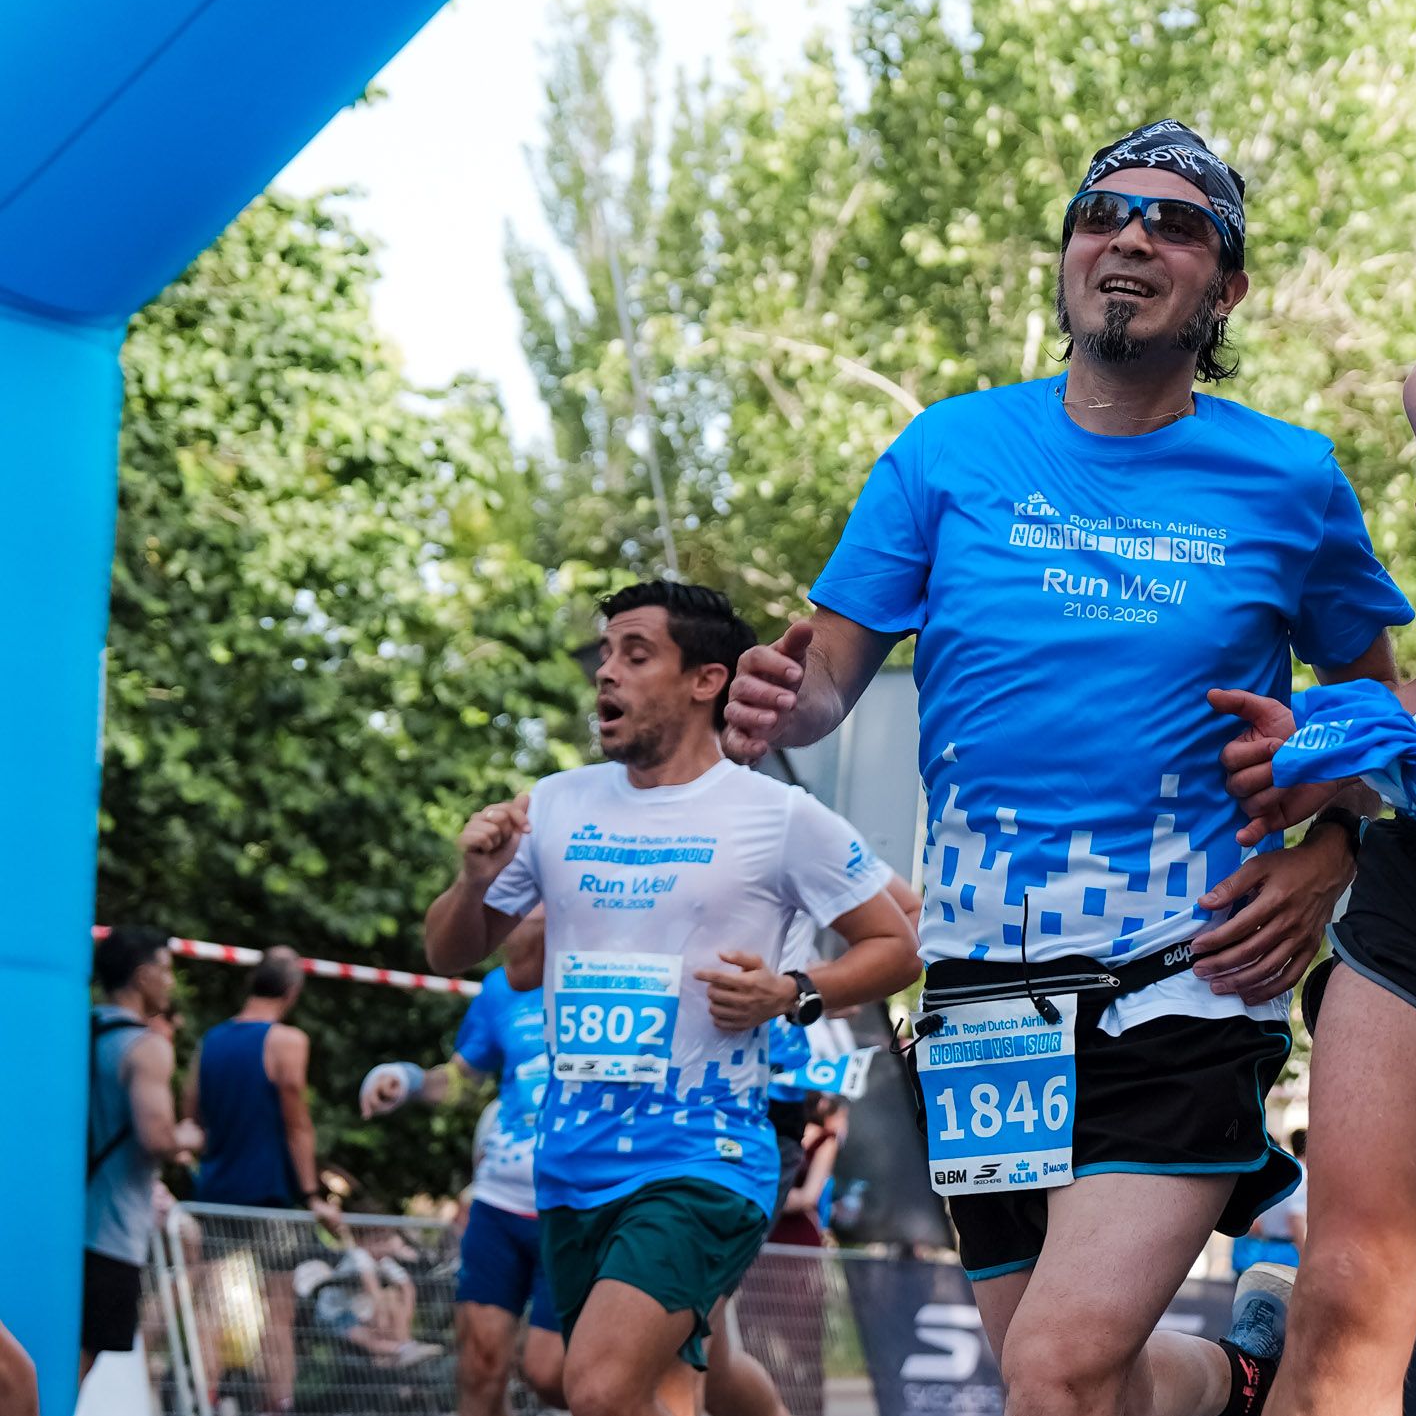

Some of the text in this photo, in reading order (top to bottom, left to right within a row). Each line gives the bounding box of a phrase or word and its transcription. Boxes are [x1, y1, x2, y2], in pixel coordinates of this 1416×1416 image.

[1013, 502, 1227, 540] KLM Royal Dutch Airlines
[1009, 524, 1226, 567] NORTE VS SUR
[1042, 567, 1187, 605] Run Well
[1063, 601, 1158, 624] 21.06.2026
[571, 832, 717, 845] KLM Royal Dutch Airlines
[671, 848, 714, 864] SUR
[579, 873, 678, 894] Run Well
[592, 897, 656, 909] 21.06.2026
[559, 1004, 667, 1045] 5802
[962, 1021, 987, 1036] Royal
[987, 1016, 1019, 1032] Dutch
[1021, 1015, 1063, 1029] Airlis
[930, 1031, 1062, 1066] NORTE VS SUR
[935, 1075, 1069, 1141] 1846
[947, 1169, 967, 1184] BM
[1008, 1171, 1038, 1184] KLM
